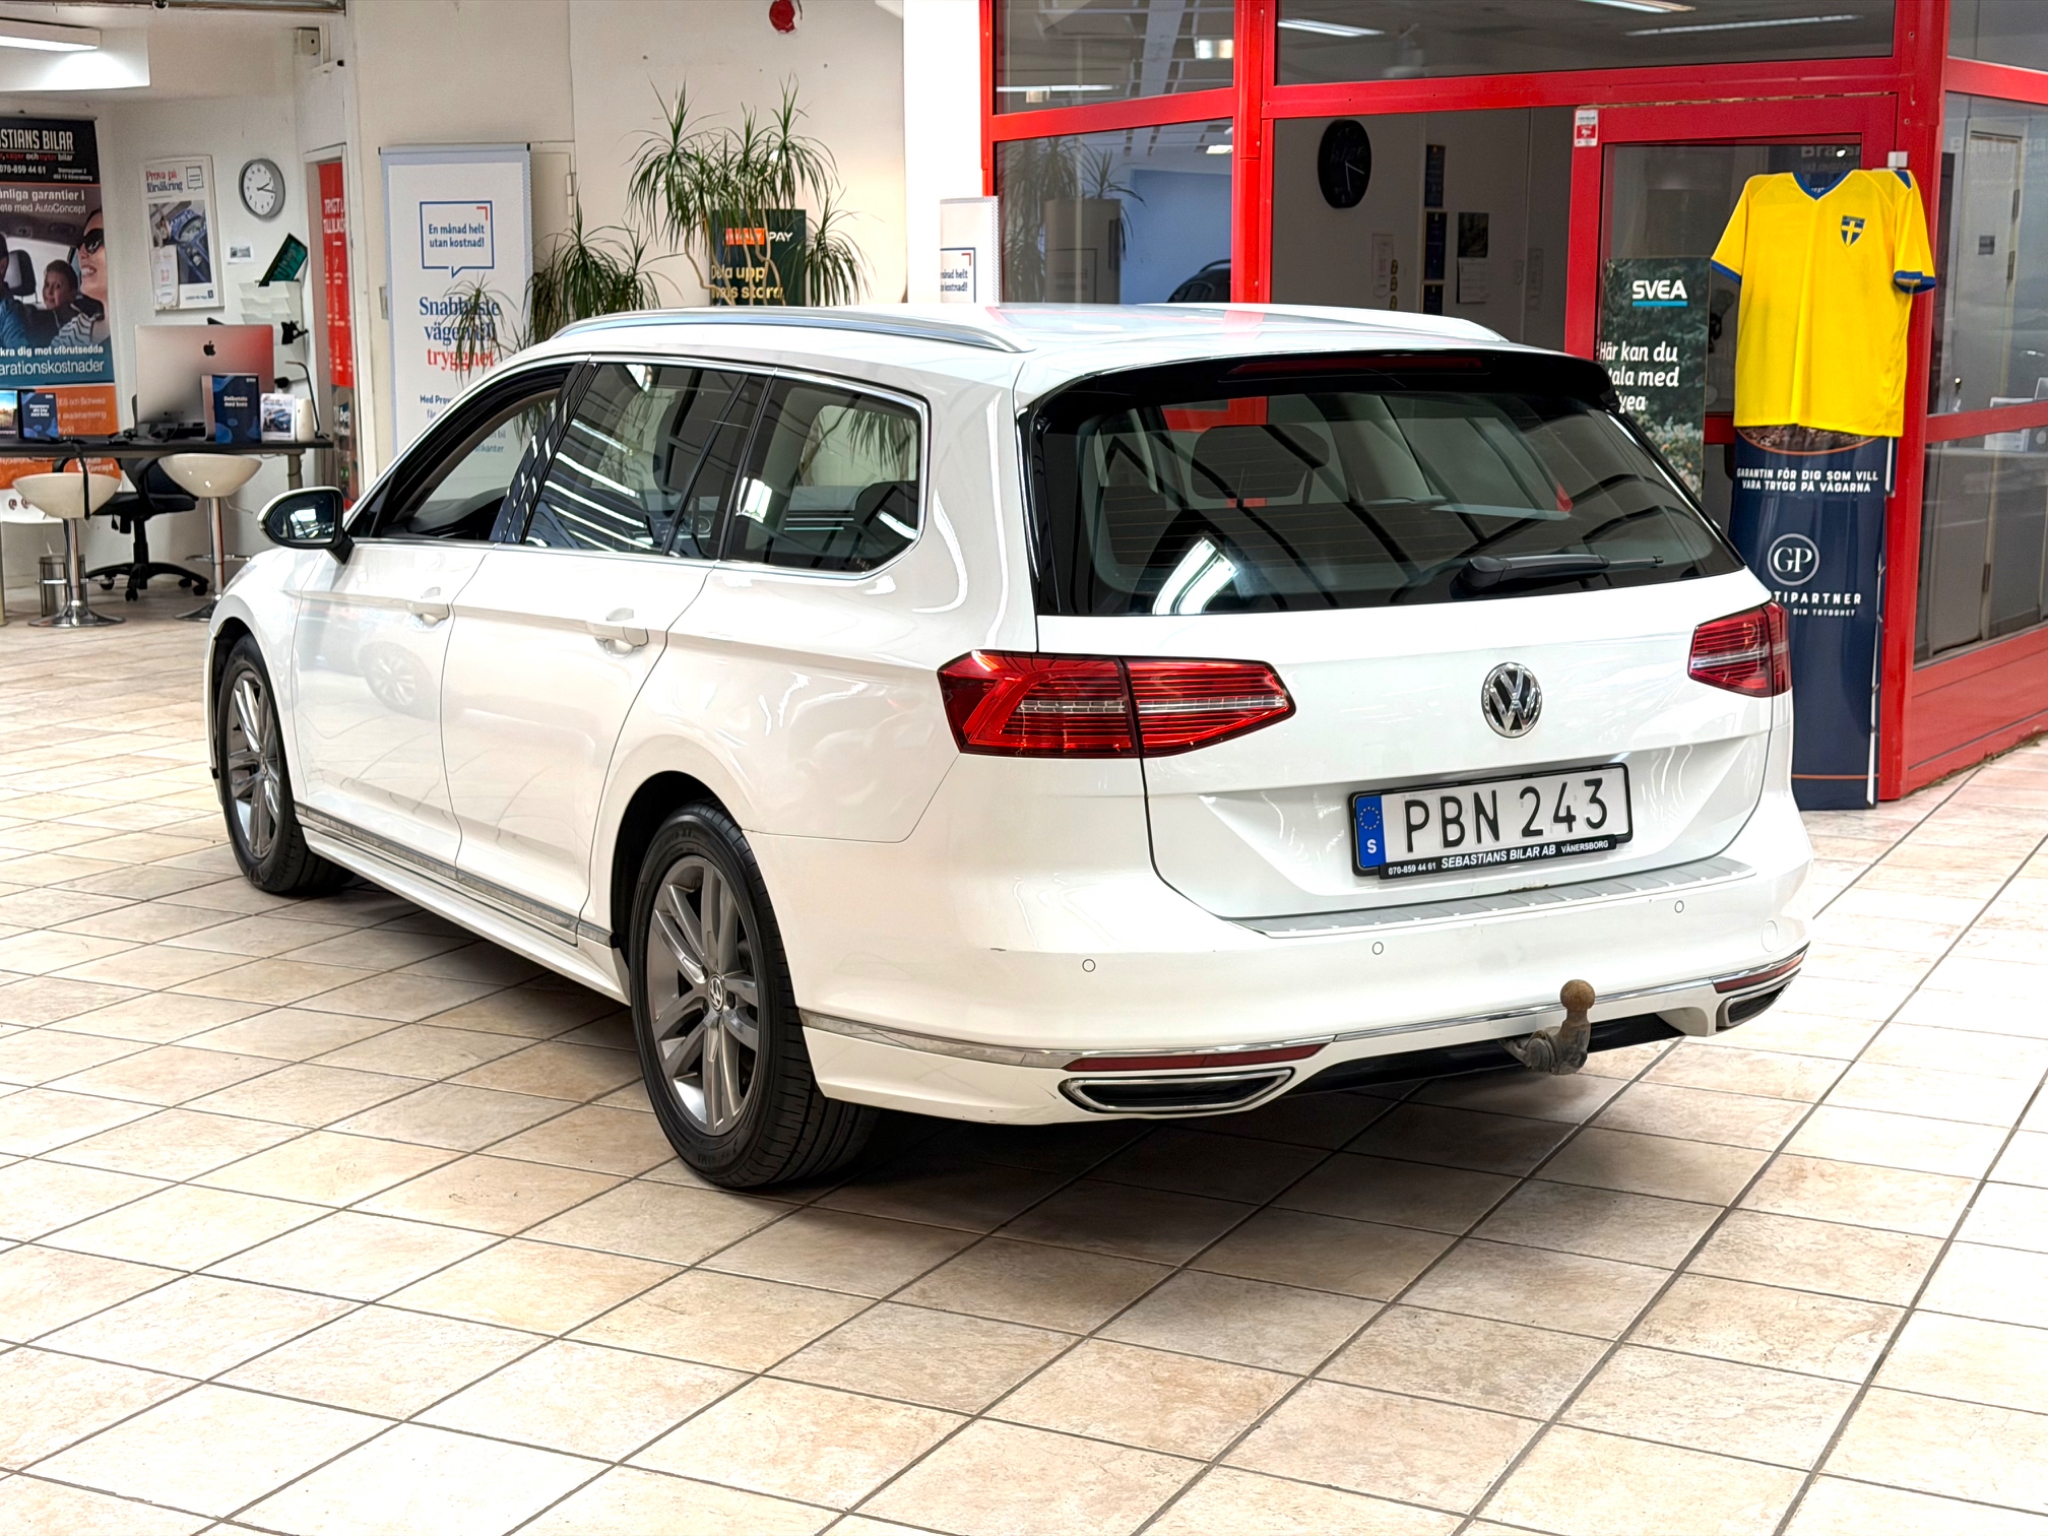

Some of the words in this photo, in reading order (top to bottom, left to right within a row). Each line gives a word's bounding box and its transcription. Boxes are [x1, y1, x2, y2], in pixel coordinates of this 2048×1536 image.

[42, 130, 74, 150] BILAR
[31, 189, 79, 201] garantier
[35, 203, 86, 214] AutoConcept
[429, 223, 439, 234] En
[440, 222, 467, 234] månad
[469, 223, 485, 234] helt
[429, 238, 448, 248] utan
[450, 236, 485, 248] kostnad!
[768, 231, 793, 242] PAY
[736, 266, 766, 283] upp
[1632, 279, 1688, 299] SVEA
[419, 296, 500, 316] Snabbste
[17, 346, 33, 357] dig
[34, 347, 52, 356] mot
[1600, 341, 1619, 361] Här
[1621, 341, 1649, 361] kan
[1653, 340, 1678, 362] du
[0, 358, 105, 376] arationskostnader
[1637, 366, 1680, 387] med
[1736, 467, 1774, 479] GARANTIN
[1777, 466, 1797, 480] FÖR
[1801, 469, 1822, 480] DIG
[1826, 470, 1851, 481] SOM
[1855, 470, 1879, 481] VILL
[1742, 479, 1761, 490] VARA
[1764, 480, 1797, 492] TRYGG
[1801, 480, 1815, 492] PÅ
[1773, 546, 1813, 573] GP
[1773, 591, 1862, 605] TIPARTNER
[1404, 789, 1500, 853] PBN
[1519, 777, 1608, 838] 243
[1367, 839, 1377, 853] S
[1388, 862, 1416, 875] 070-859
[1417, 863, 1427, 872] 44
[1441, 851, 1507, 869] SEBASTIANS
[1510, 845, 1540, 860] BILAR
[1542, 843, 1556, 857] AB
[1561, 840, 1608, 853] VÄNERSBORG
